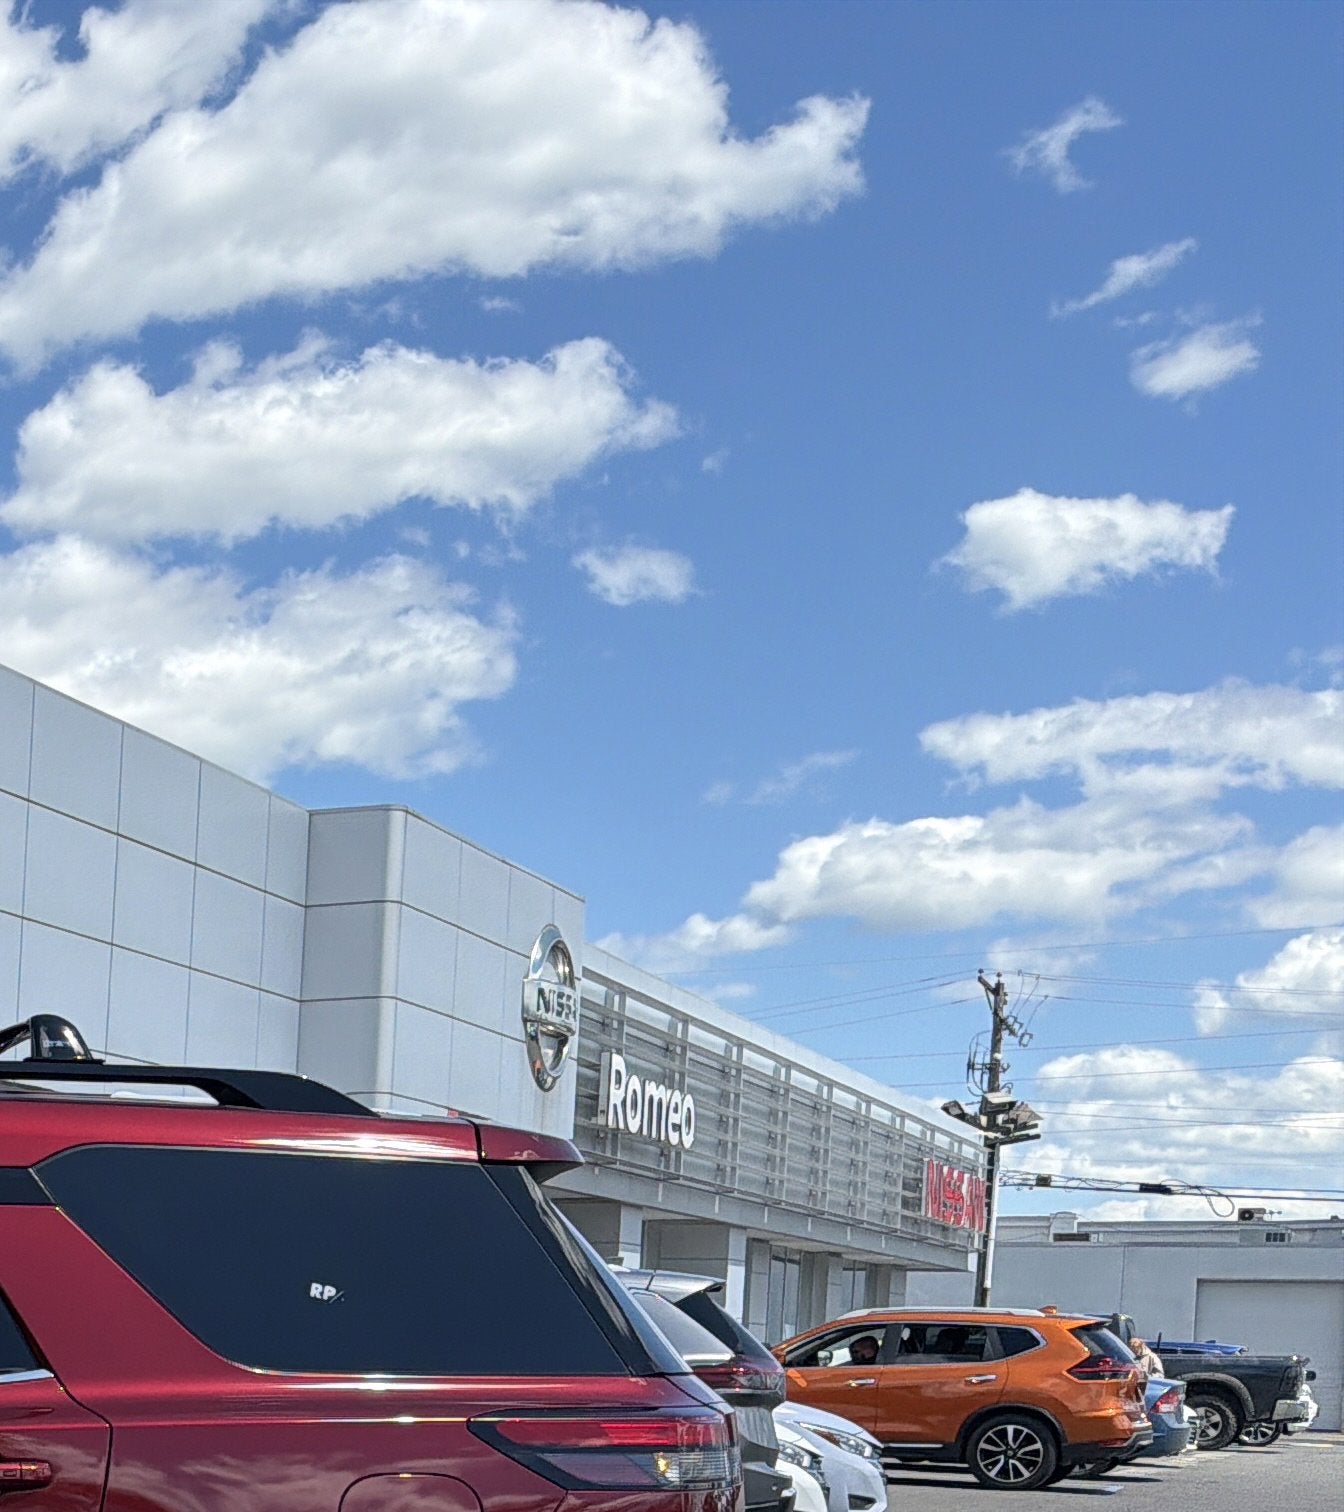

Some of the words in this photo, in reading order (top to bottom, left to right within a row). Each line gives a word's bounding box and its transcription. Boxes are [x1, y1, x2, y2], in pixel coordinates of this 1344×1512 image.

[535, 987, 577, 1021] NISS
[606, 1052, 695, 1149] Romeo
[924, 1159, 987, 1232] NISSAN
[309, 1282, 336, 1300] RP
